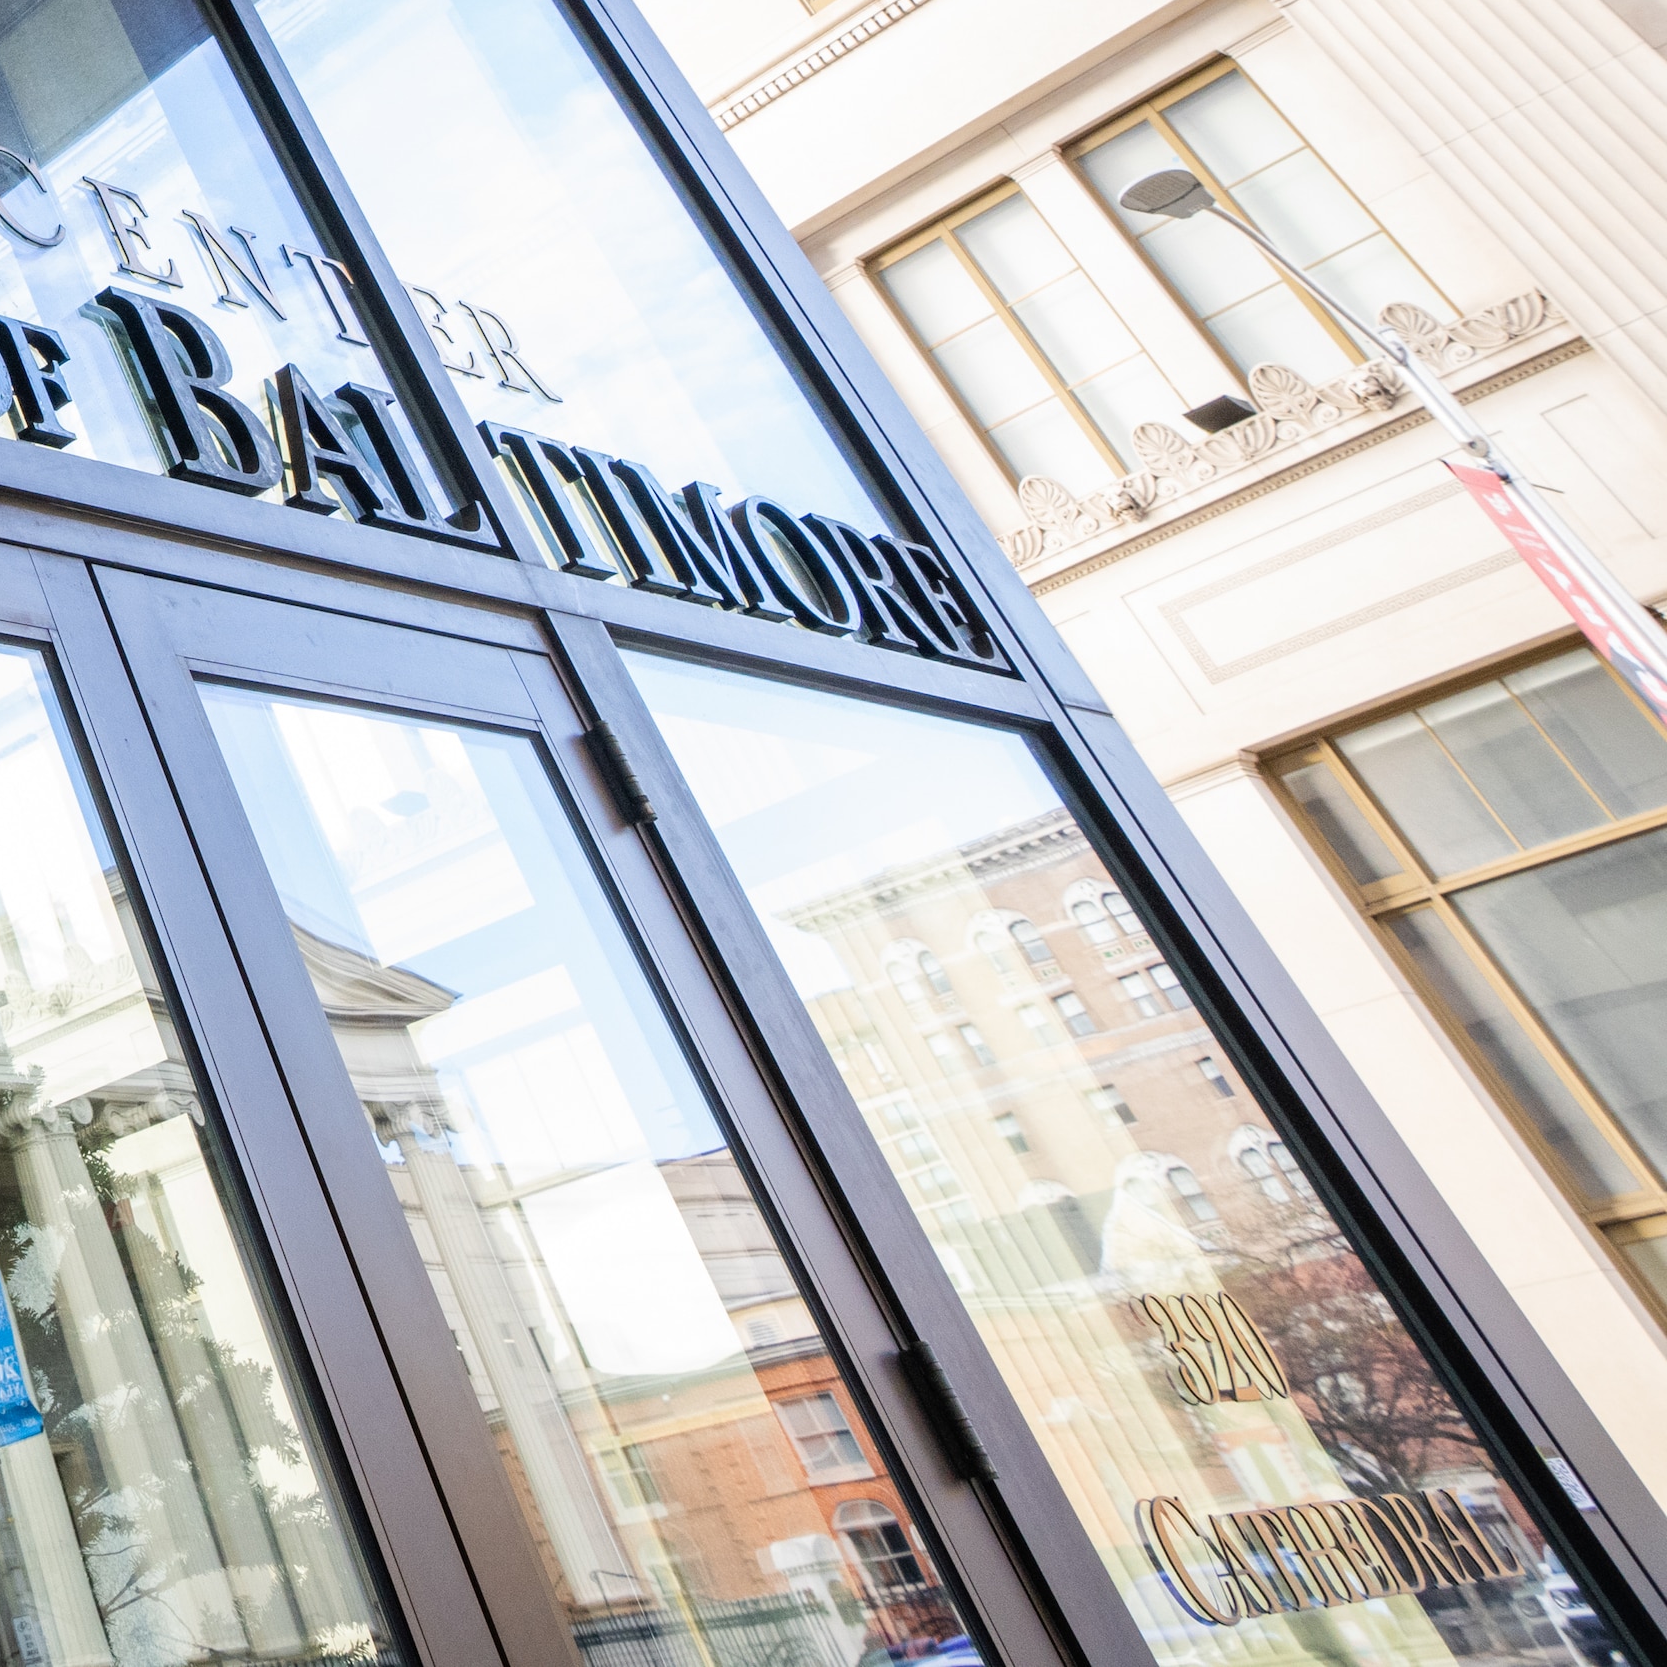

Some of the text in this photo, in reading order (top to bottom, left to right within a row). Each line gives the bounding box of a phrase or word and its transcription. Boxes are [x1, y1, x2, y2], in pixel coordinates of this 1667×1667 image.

[93, 285, 1026, 681] BALTIMORE
[1142, 1290, 1290, 1405] 320
[1148, 1488, 1526, 1626] CATHEDRAL
